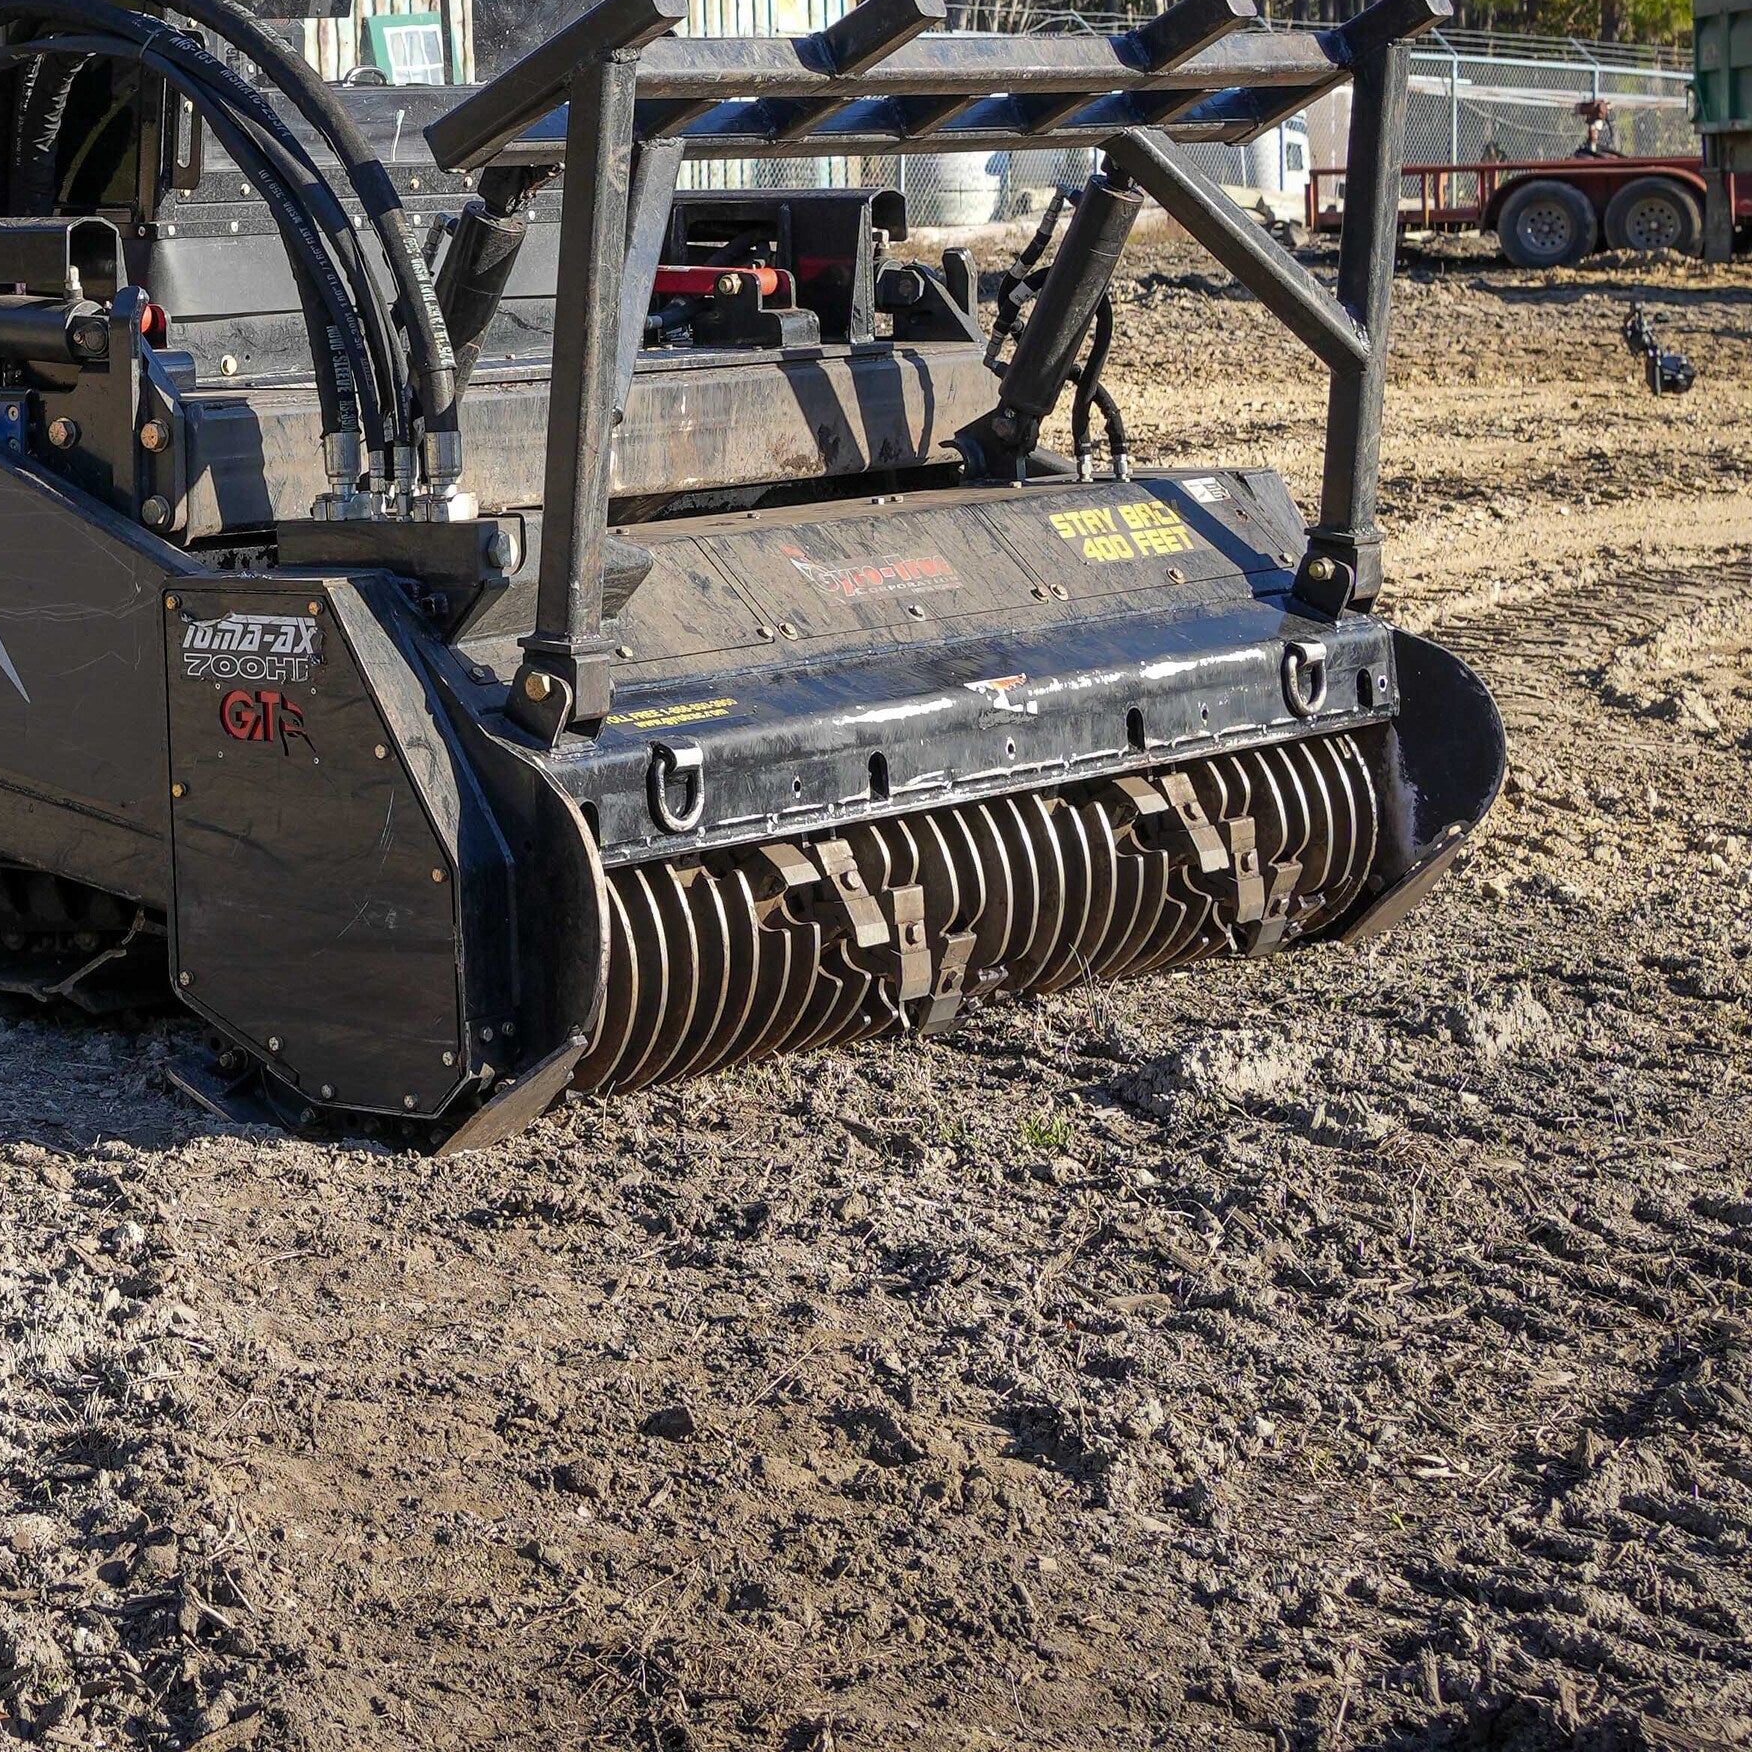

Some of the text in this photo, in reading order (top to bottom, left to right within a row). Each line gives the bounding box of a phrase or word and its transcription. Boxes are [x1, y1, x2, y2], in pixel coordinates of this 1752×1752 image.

[1049, 499, 1190, 539] STAY BACK
[1082, 525, 1195, 563] 400 FEET
[629, 708, 664, 720] FREE
